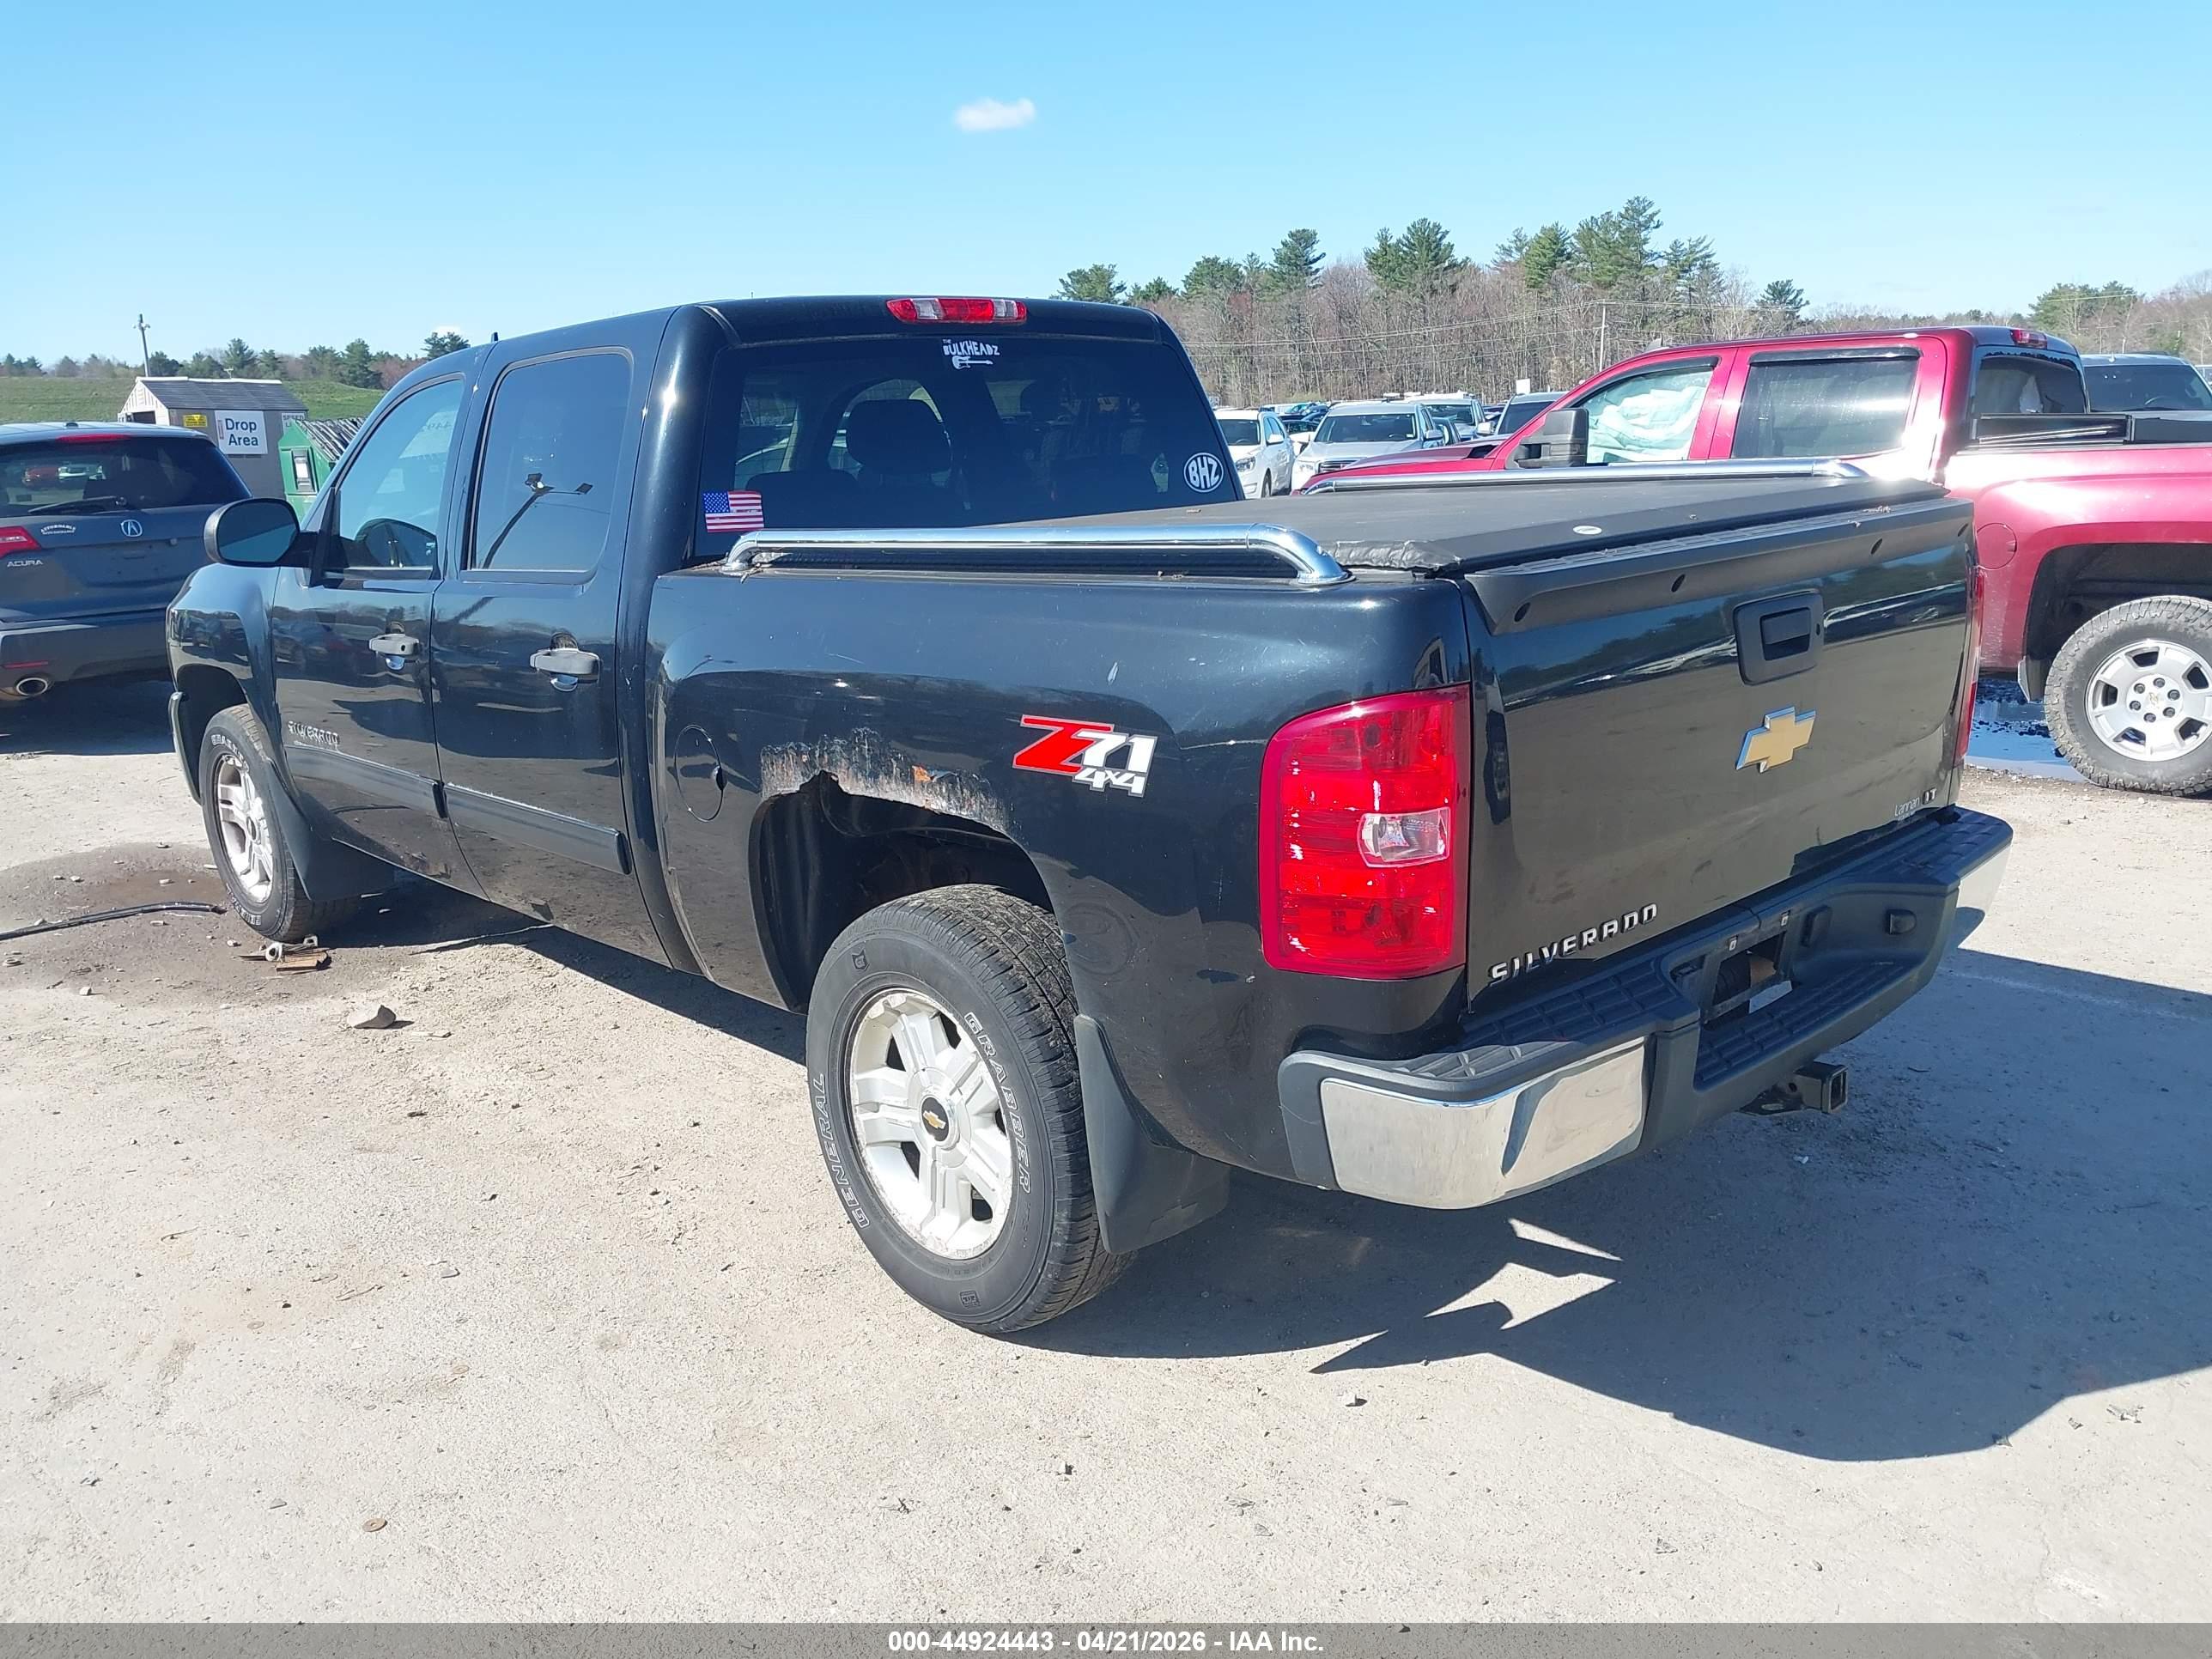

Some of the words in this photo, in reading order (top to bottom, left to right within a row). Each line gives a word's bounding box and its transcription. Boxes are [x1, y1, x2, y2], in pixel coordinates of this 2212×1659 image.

[943, 340, 1000, 356] BULKHEADZ
[225, 418, 257, 433] Drop
[228, 434, 258, 446] Area
[1188, 456, 1219, 489] BHZ
[1013, 714, 1158, 775] Z71
[1489, 903, 1657, 981] SILVERADO
[964, 1012, 1030, 1193] GRABBER
[813, 1073, 870, 1228] GENERAL
